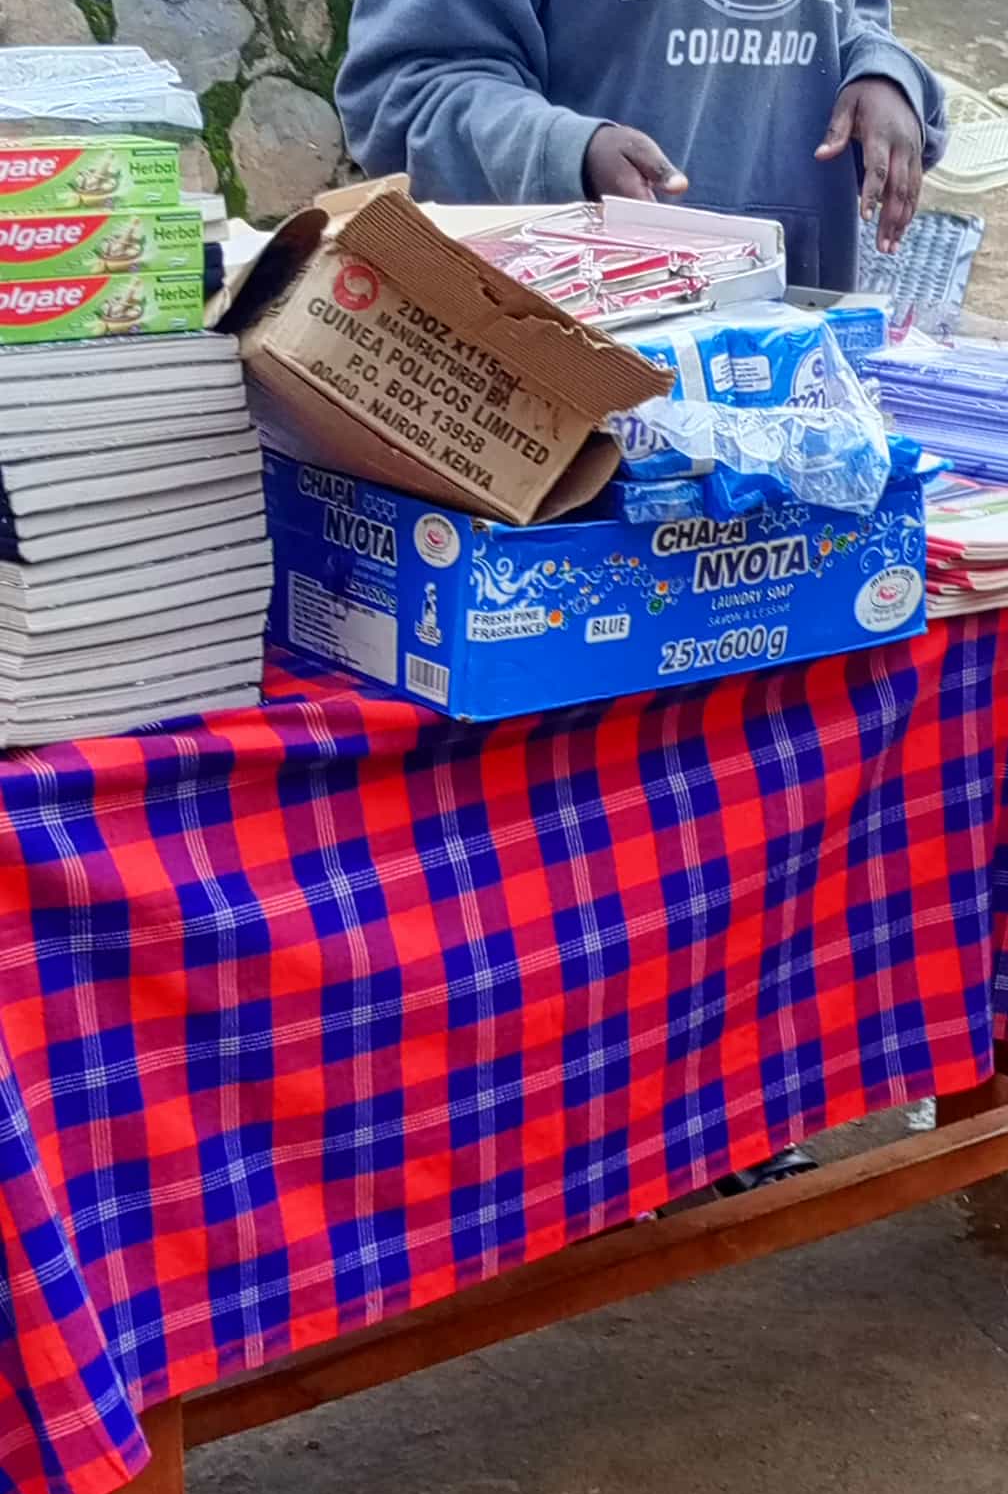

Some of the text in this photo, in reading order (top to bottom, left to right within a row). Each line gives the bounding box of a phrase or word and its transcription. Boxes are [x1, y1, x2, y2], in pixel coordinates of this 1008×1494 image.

[666, 28, 817, 66] COLORADO
[0, 156, 57, 182] gate
[129, 159, 177, 174] Herbal
[0, 223, 82, 251] olgate
[153, 225, 201, 241] Herbal
[0, 286, 83, 314] olgate
[154, 287, 201, 301] Herbal
[398, 300, 453, 343] 2DOZ
[376, 312, 487, 394] MANUFACTURED
[307, 297, 388, 357] GUINEA
[386, 348, 473, 414] POLICOS
[471, 406, 551, 466] LIMITED
[346, 354, 487, 455] P.O. BOX 13958
[310, 359, 361, 400] 00400
[366, 398, 436, 457] NAIROBI,
[439, 446, 494, 492] KENYA
[324, 505, 398, 567] NYOTA
[652, 518, 746, 556] CHAPA
[692, 535, 809, 594] NYOTA
[711, 589, 763, 610] LAUNDRY
[472, 621, 545, 639] FRAGRANCE
[473, 609, 540, 625] FRESH PINE
[591, 617, 627, 637] BLUE
